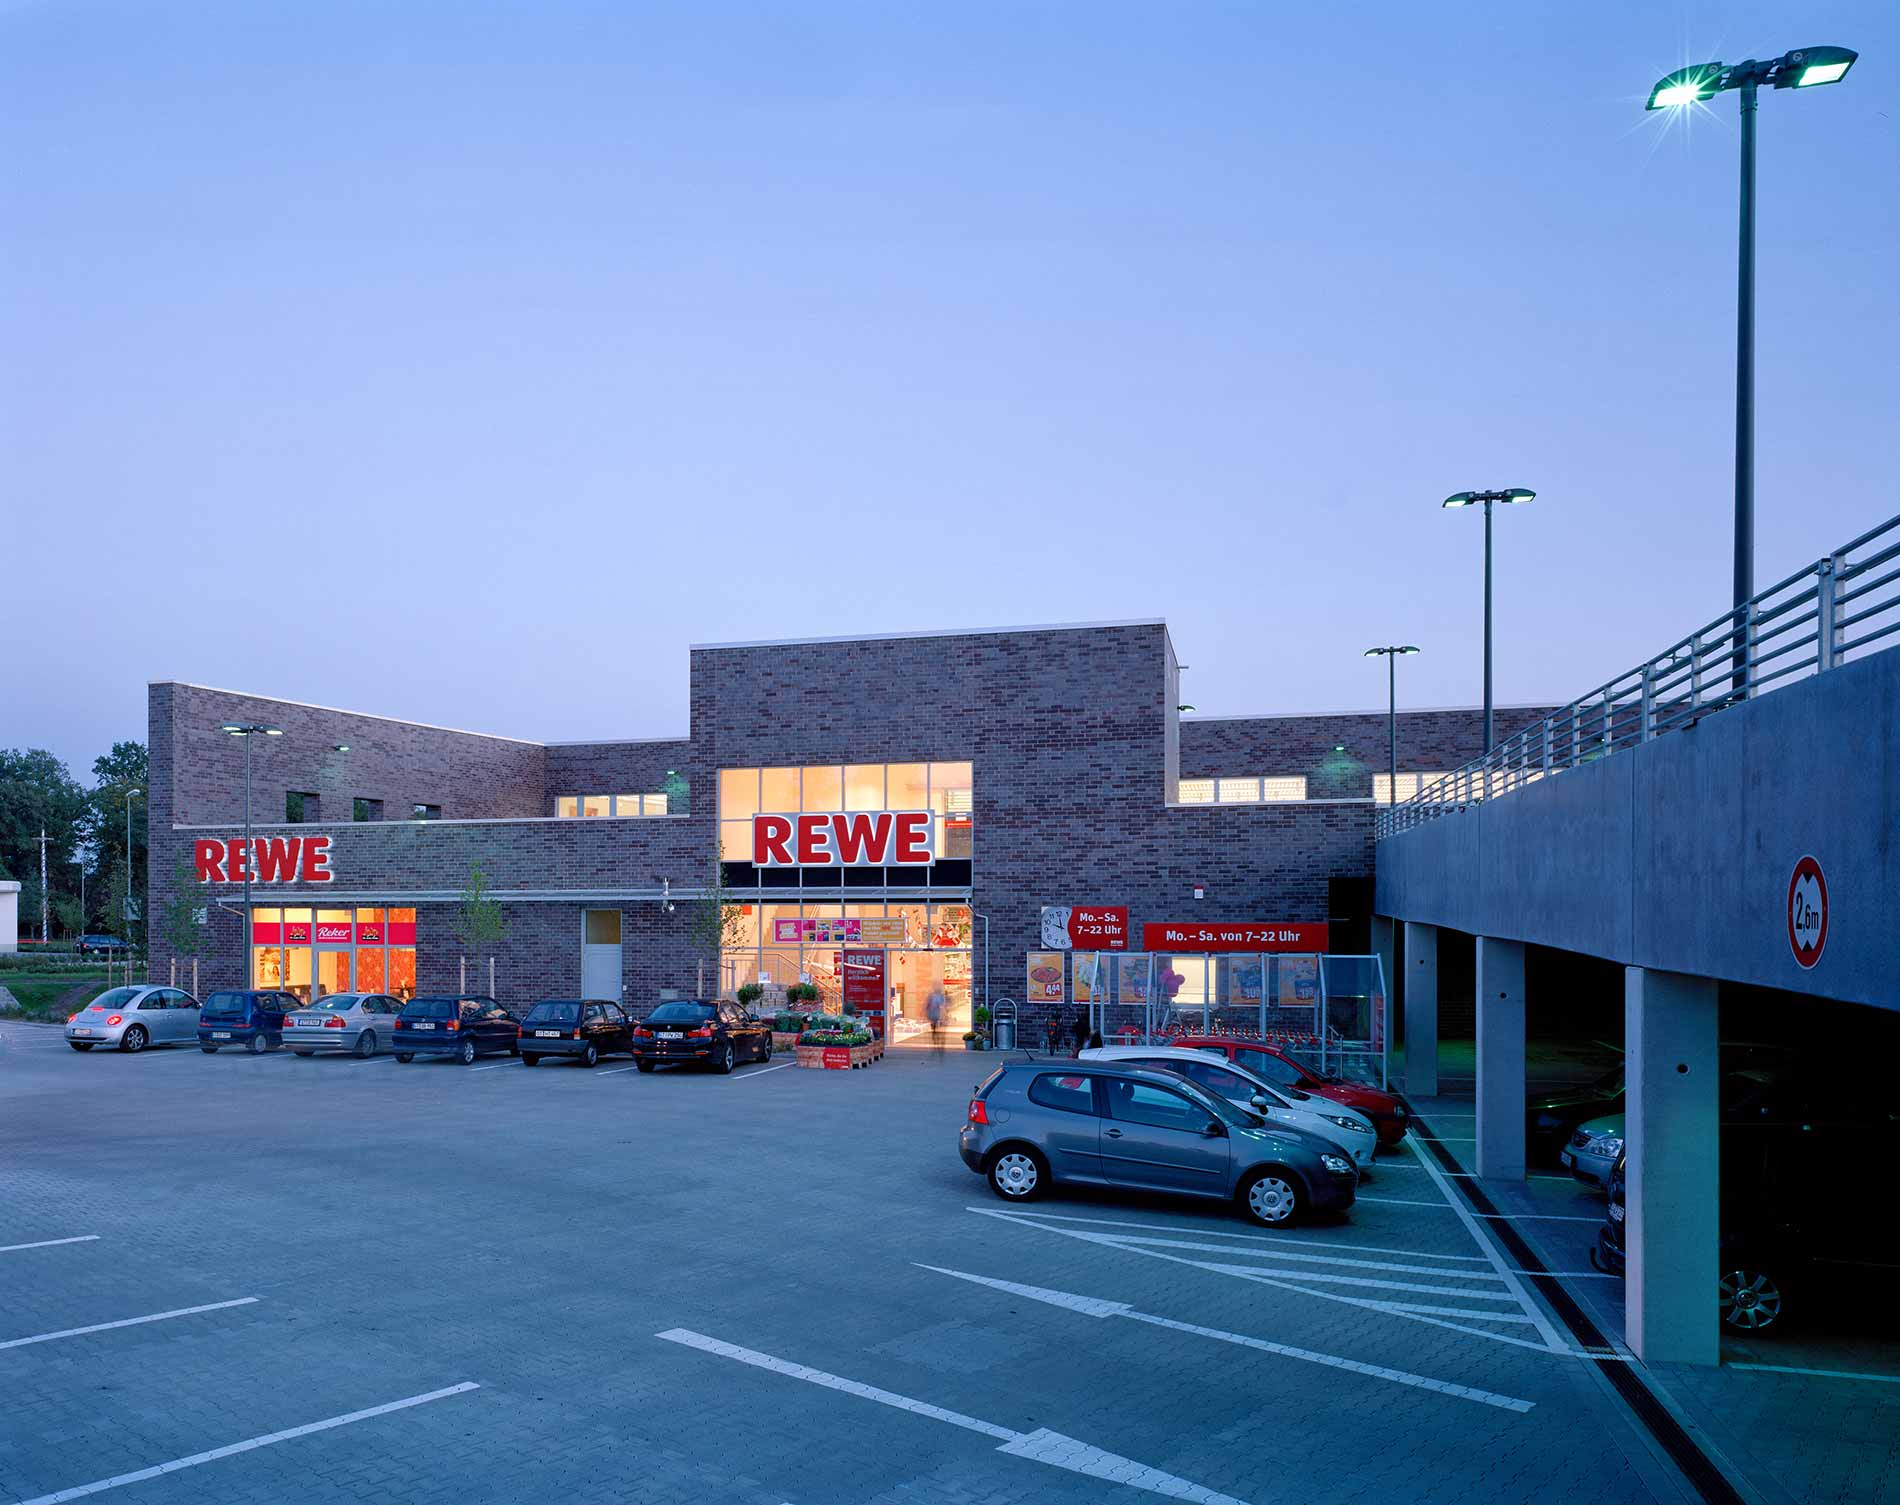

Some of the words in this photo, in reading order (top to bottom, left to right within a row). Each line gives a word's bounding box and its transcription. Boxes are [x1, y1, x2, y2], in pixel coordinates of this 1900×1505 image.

[754, 812, 931, 865] REWE
[194, 837, 333, 882] REWE
[318, 927, 350, 936] Reker
[1104, 925, 1121, 935] Uhr
[1220, 932, 1242, 941] von
[1279, 931, 1300, 941] Uhr
[847, 955, 882, 966] REWE
